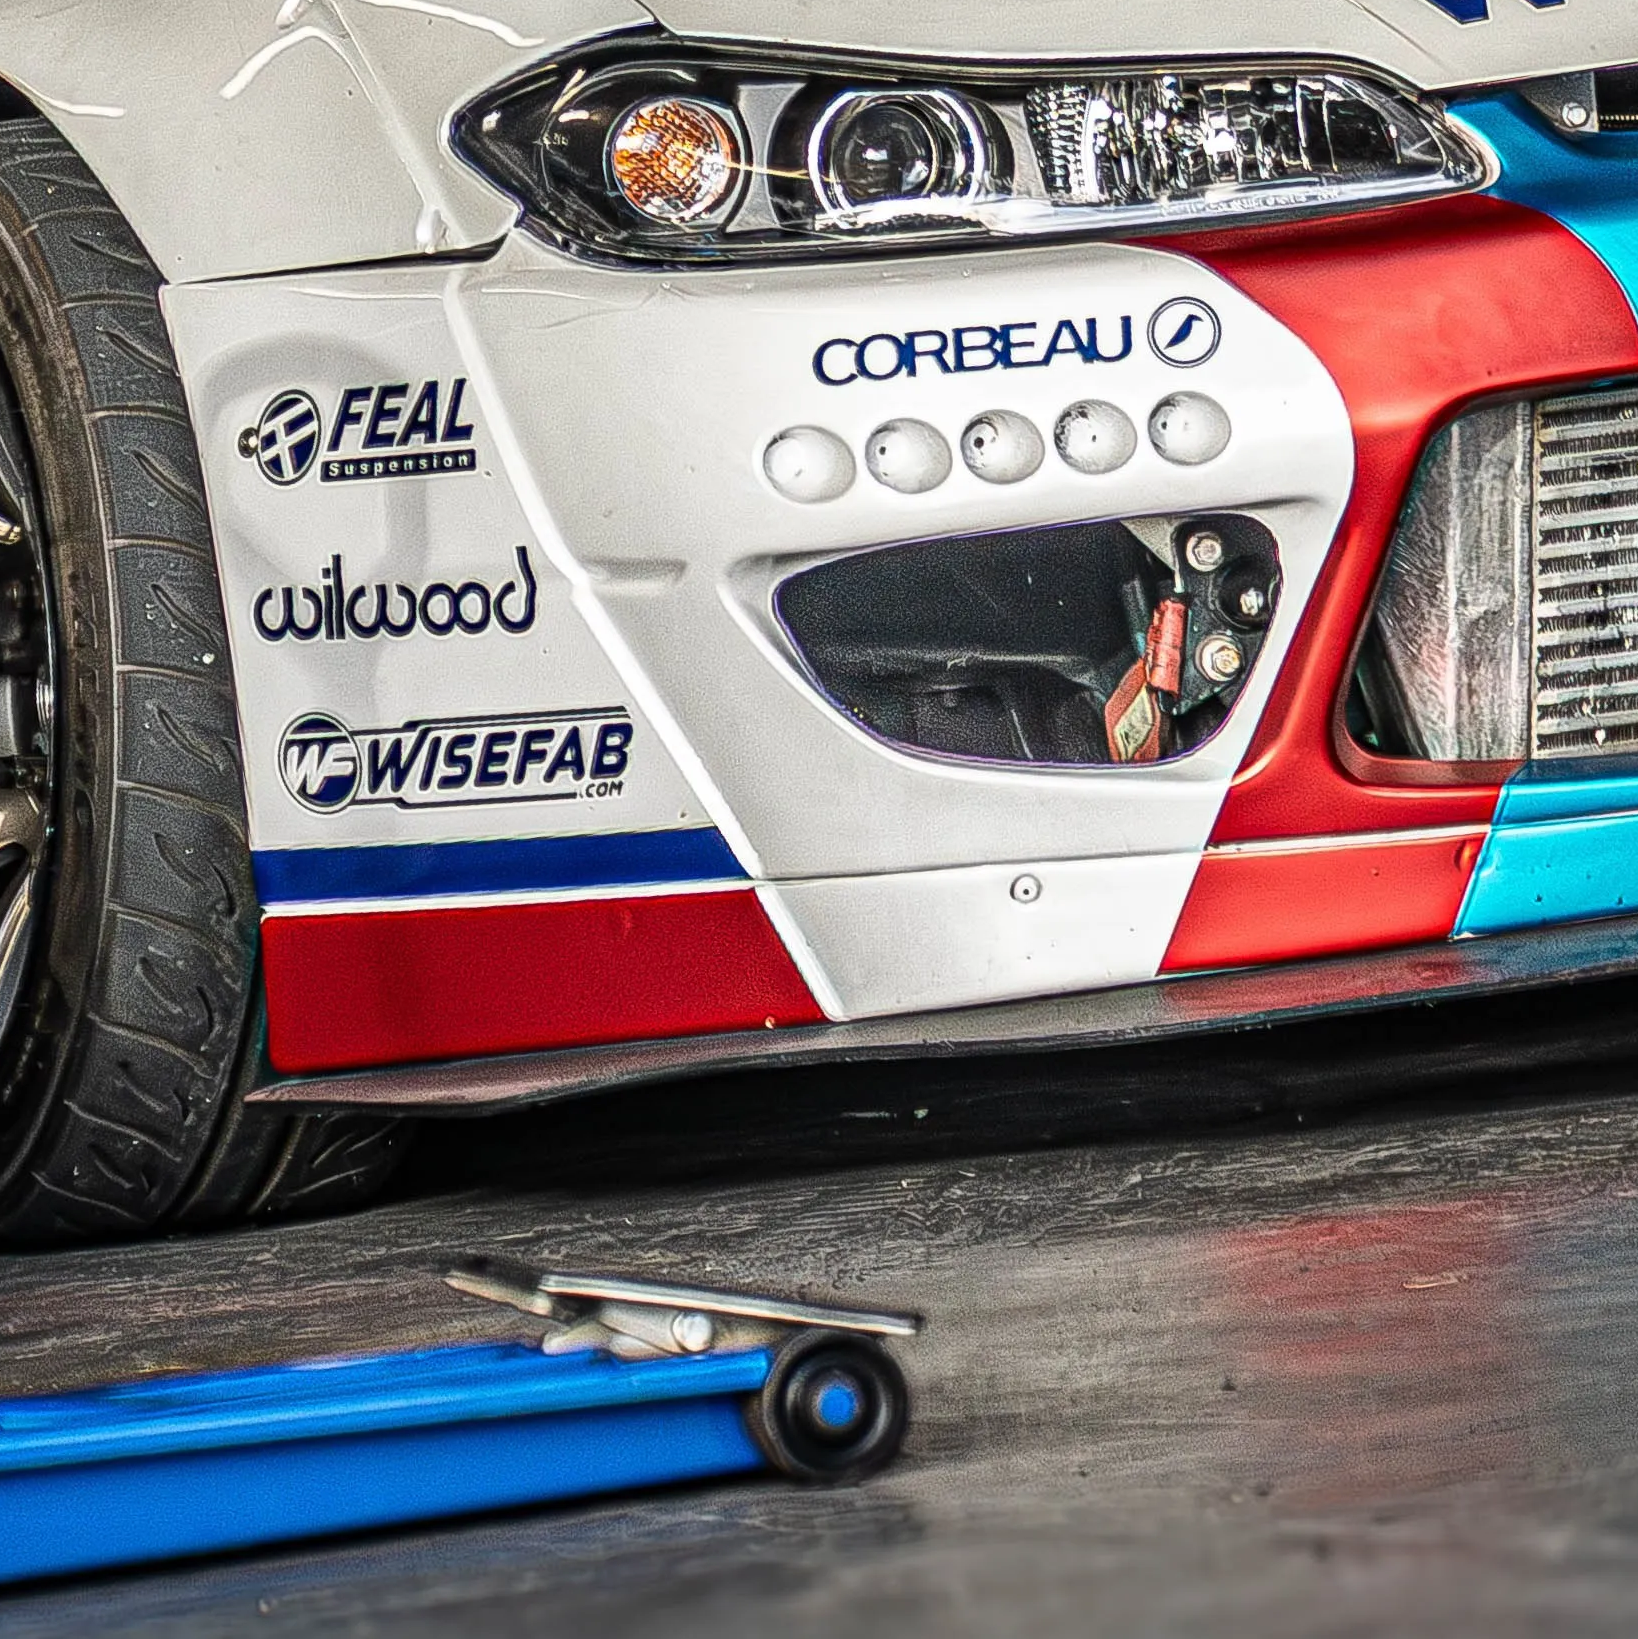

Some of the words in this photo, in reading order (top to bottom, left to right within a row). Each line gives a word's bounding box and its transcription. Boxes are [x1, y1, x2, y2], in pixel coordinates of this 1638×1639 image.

[811, 313, 1134, 387] CORBEAU
[326, 377, 474, 453] FEAL
[326, 452, 470, 480] Suspension
[253, 545, 538, 641] wilwood
[368, 722, 634, 794] WISEFAB
